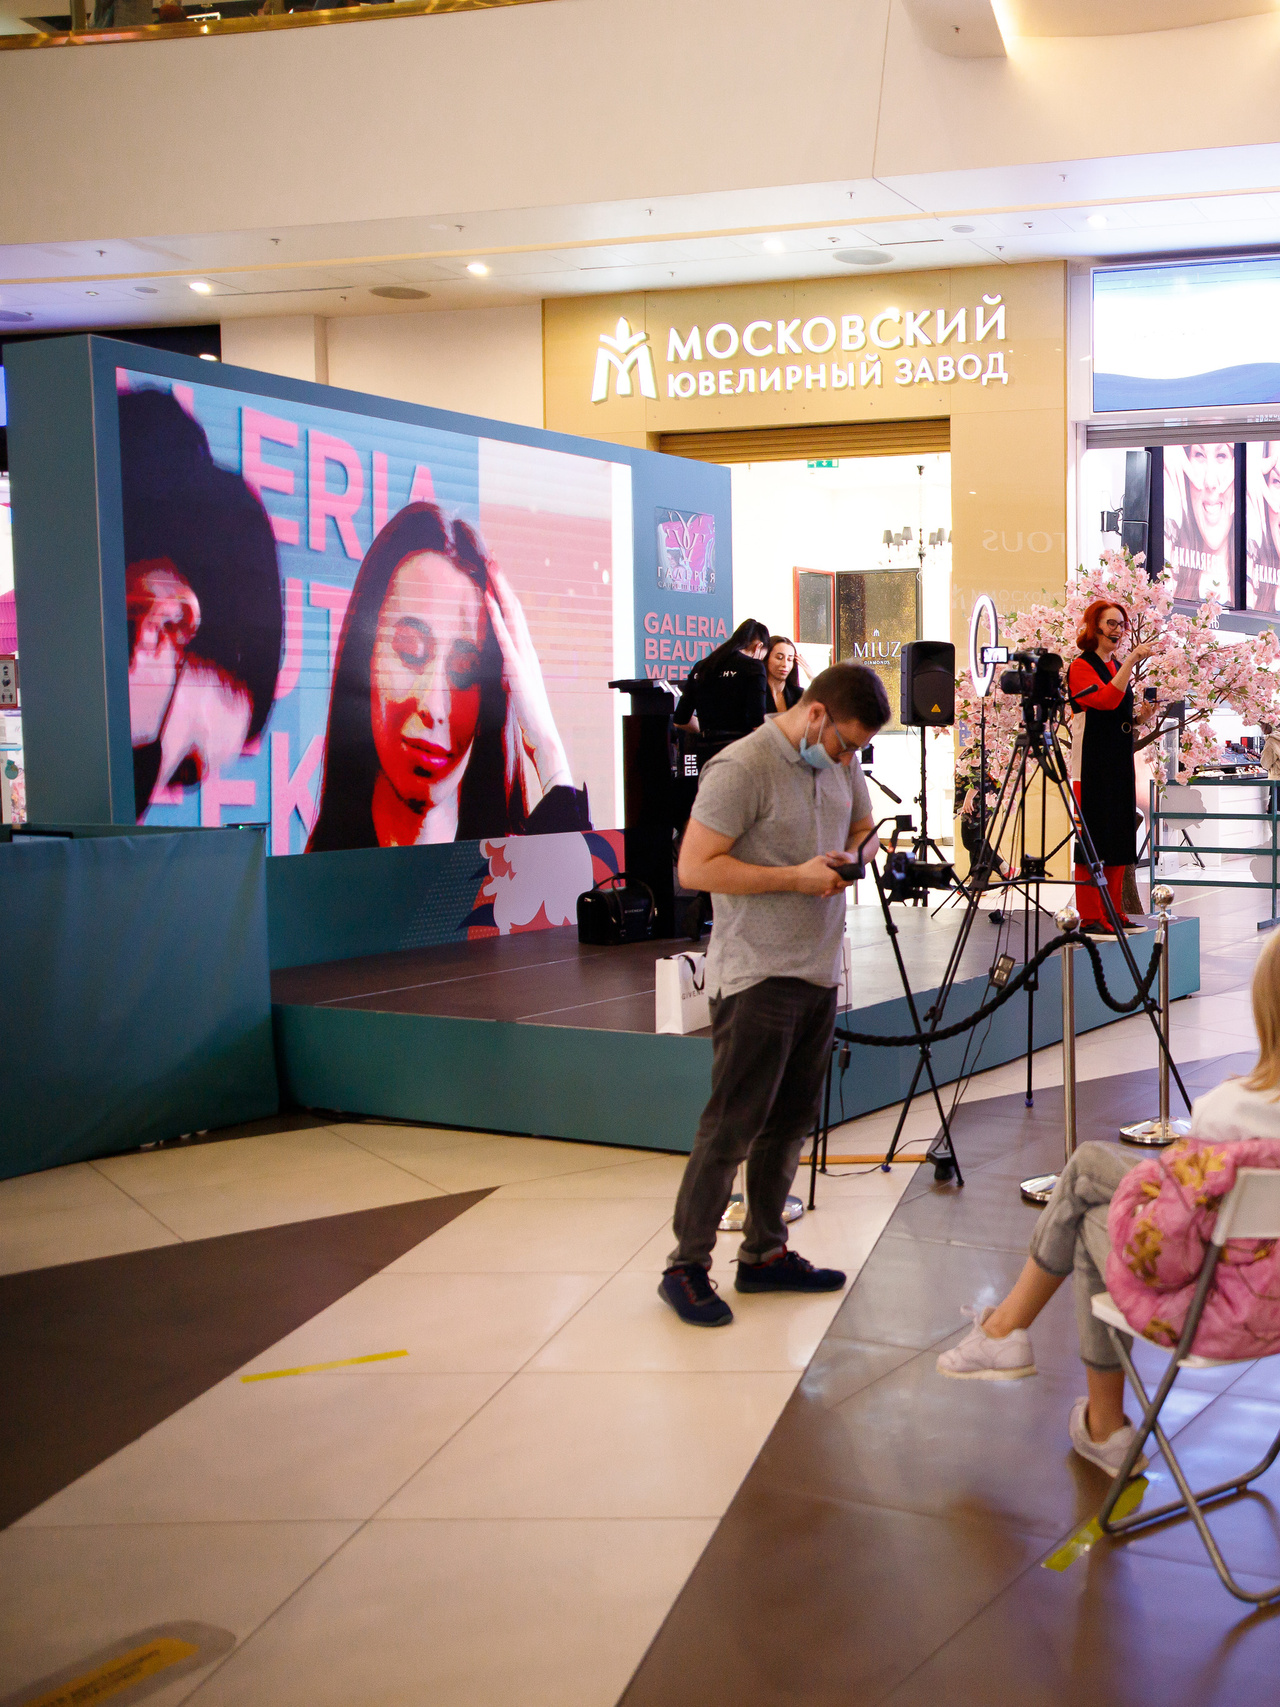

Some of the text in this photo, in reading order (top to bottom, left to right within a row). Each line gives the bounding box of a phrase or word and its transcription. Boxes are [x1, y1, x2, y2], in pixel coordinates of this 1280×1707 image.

[667, 293, 1006, 361] МОСКОВСКИЙ
[667, 351, 1009, 398] ЮВЕЛИРНЫЙ ЗАВОД
[643, 612, 728, 639] GALERIA
[853, 641, 902, 658] MIUZ
